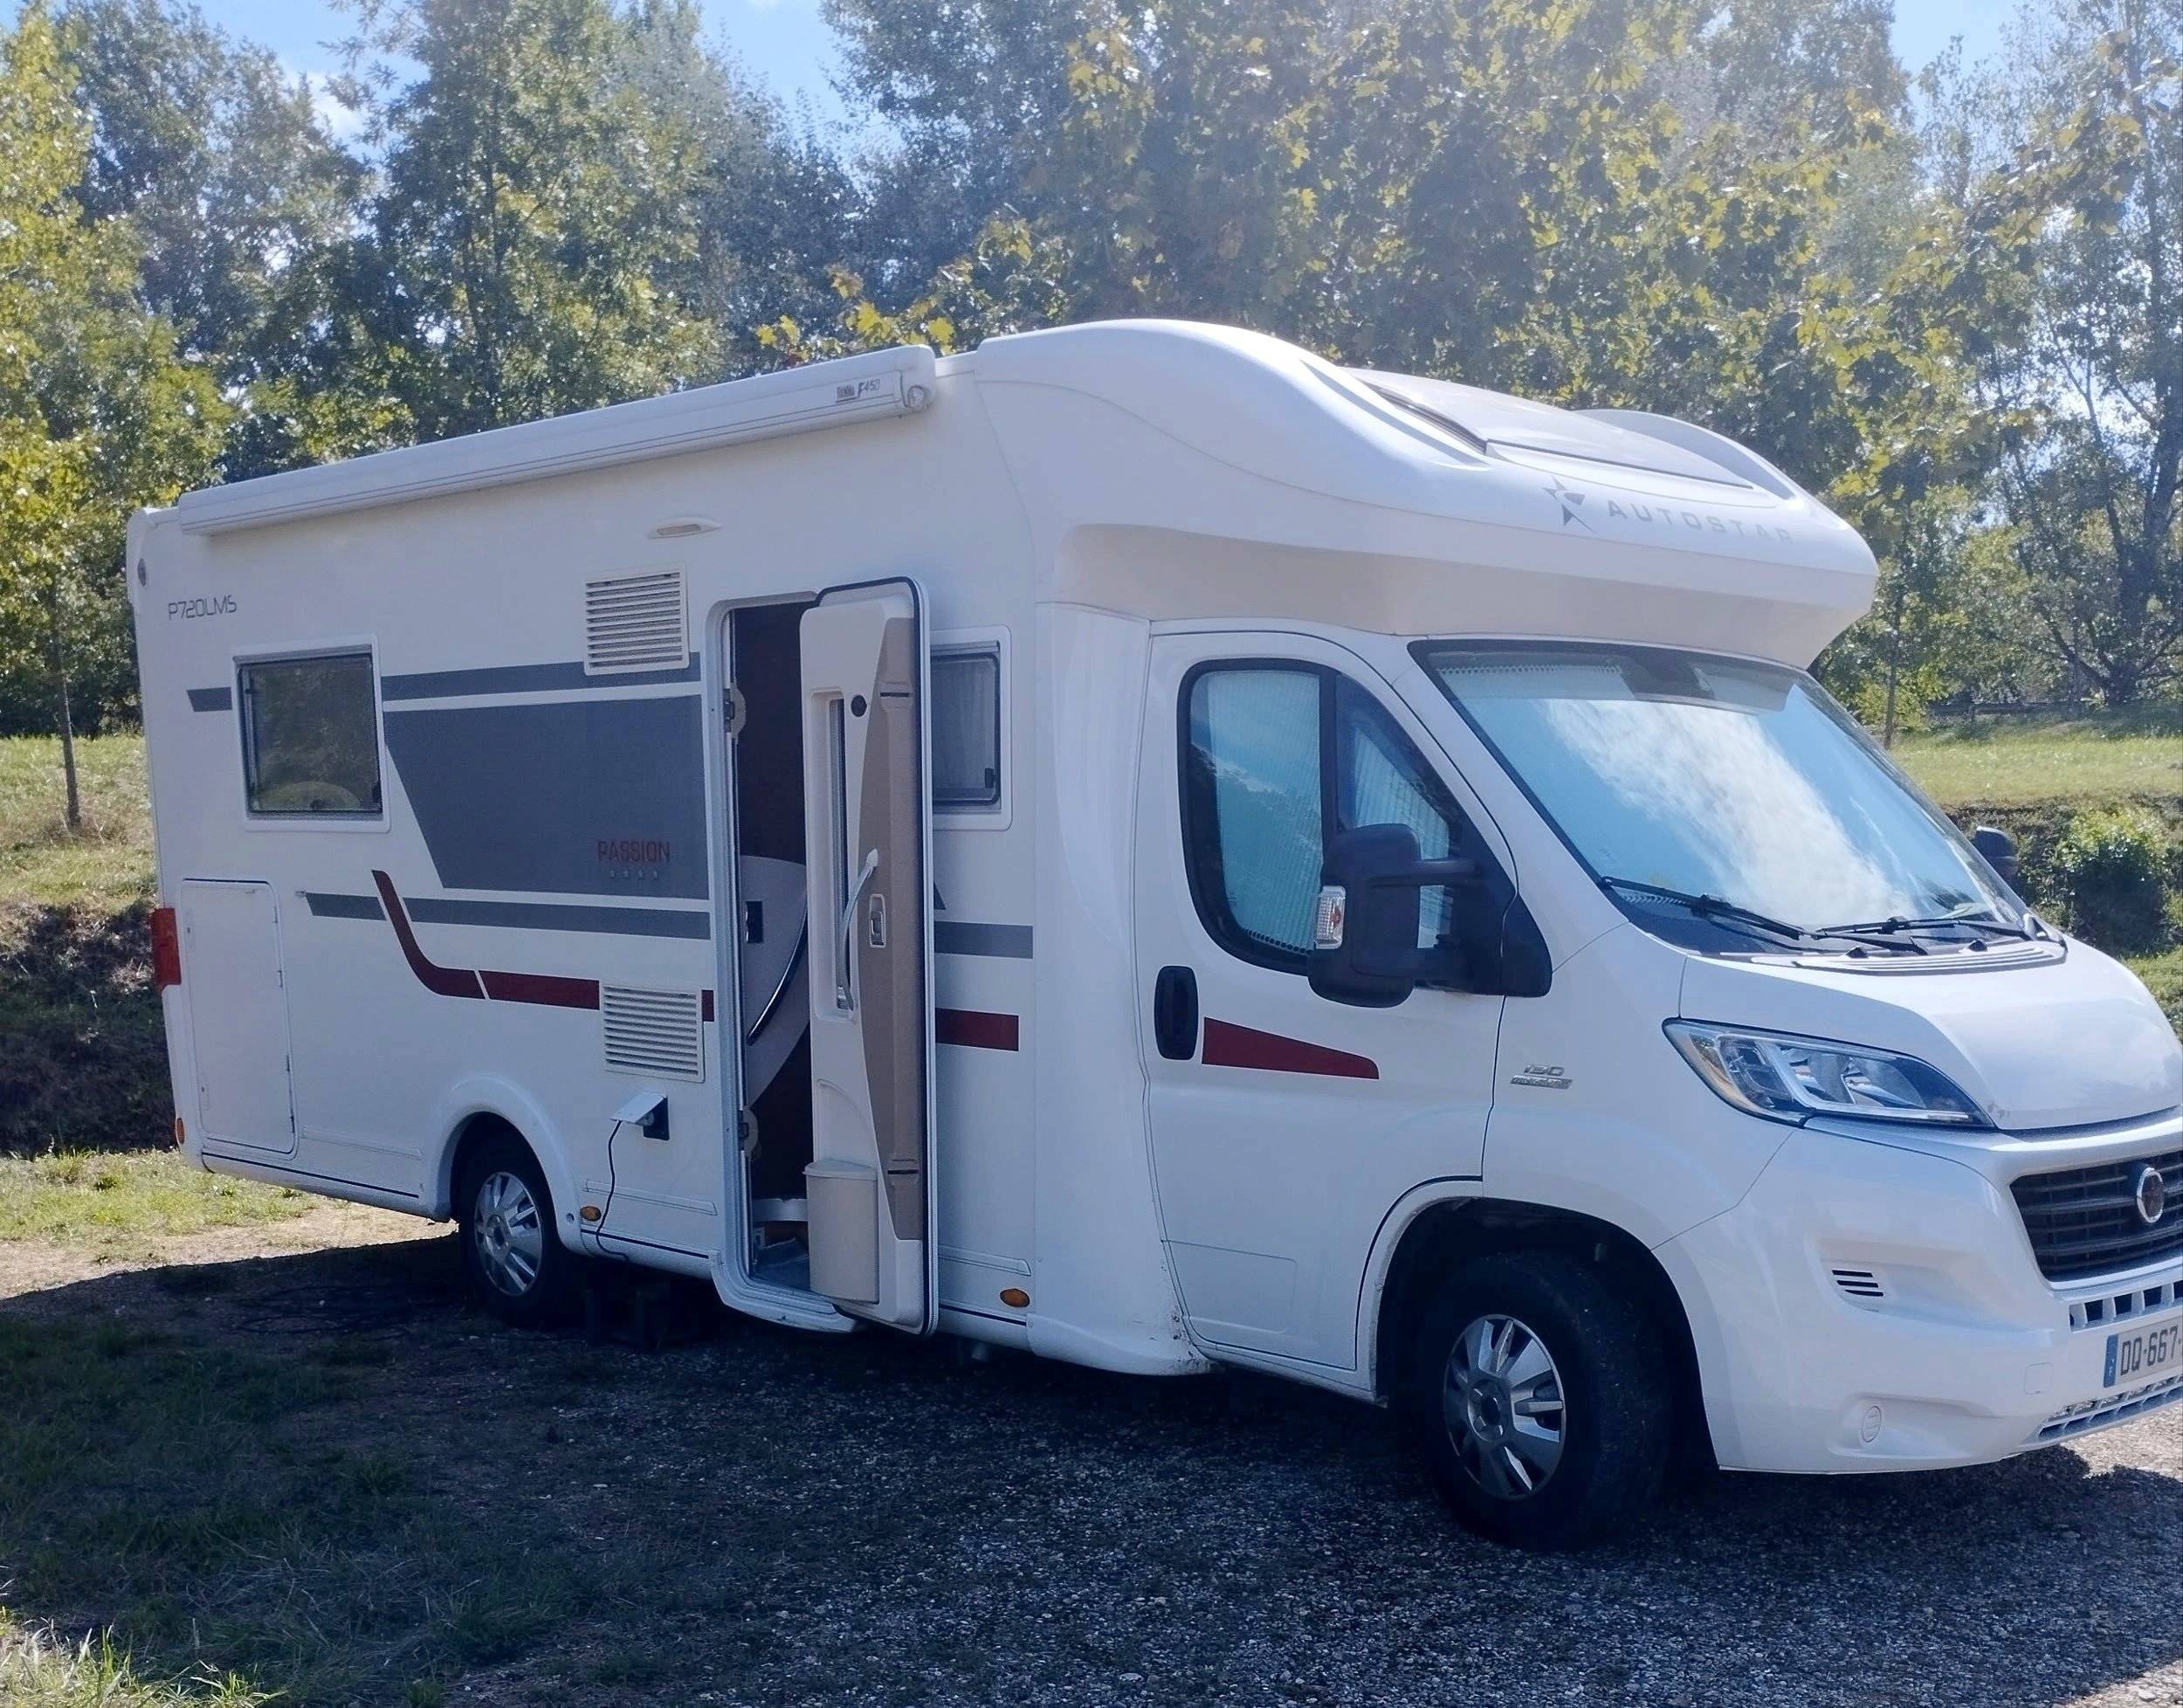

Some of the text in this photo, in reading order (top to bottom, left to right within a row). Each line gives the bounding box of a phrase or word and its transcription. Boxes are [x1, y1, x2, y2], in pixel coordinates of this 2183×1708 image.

[1608, 500, 1793, 545] AUTOSTAR
[168, 595, 238, 621] P720LMS
[597, 840, 670, 863] PASSION
